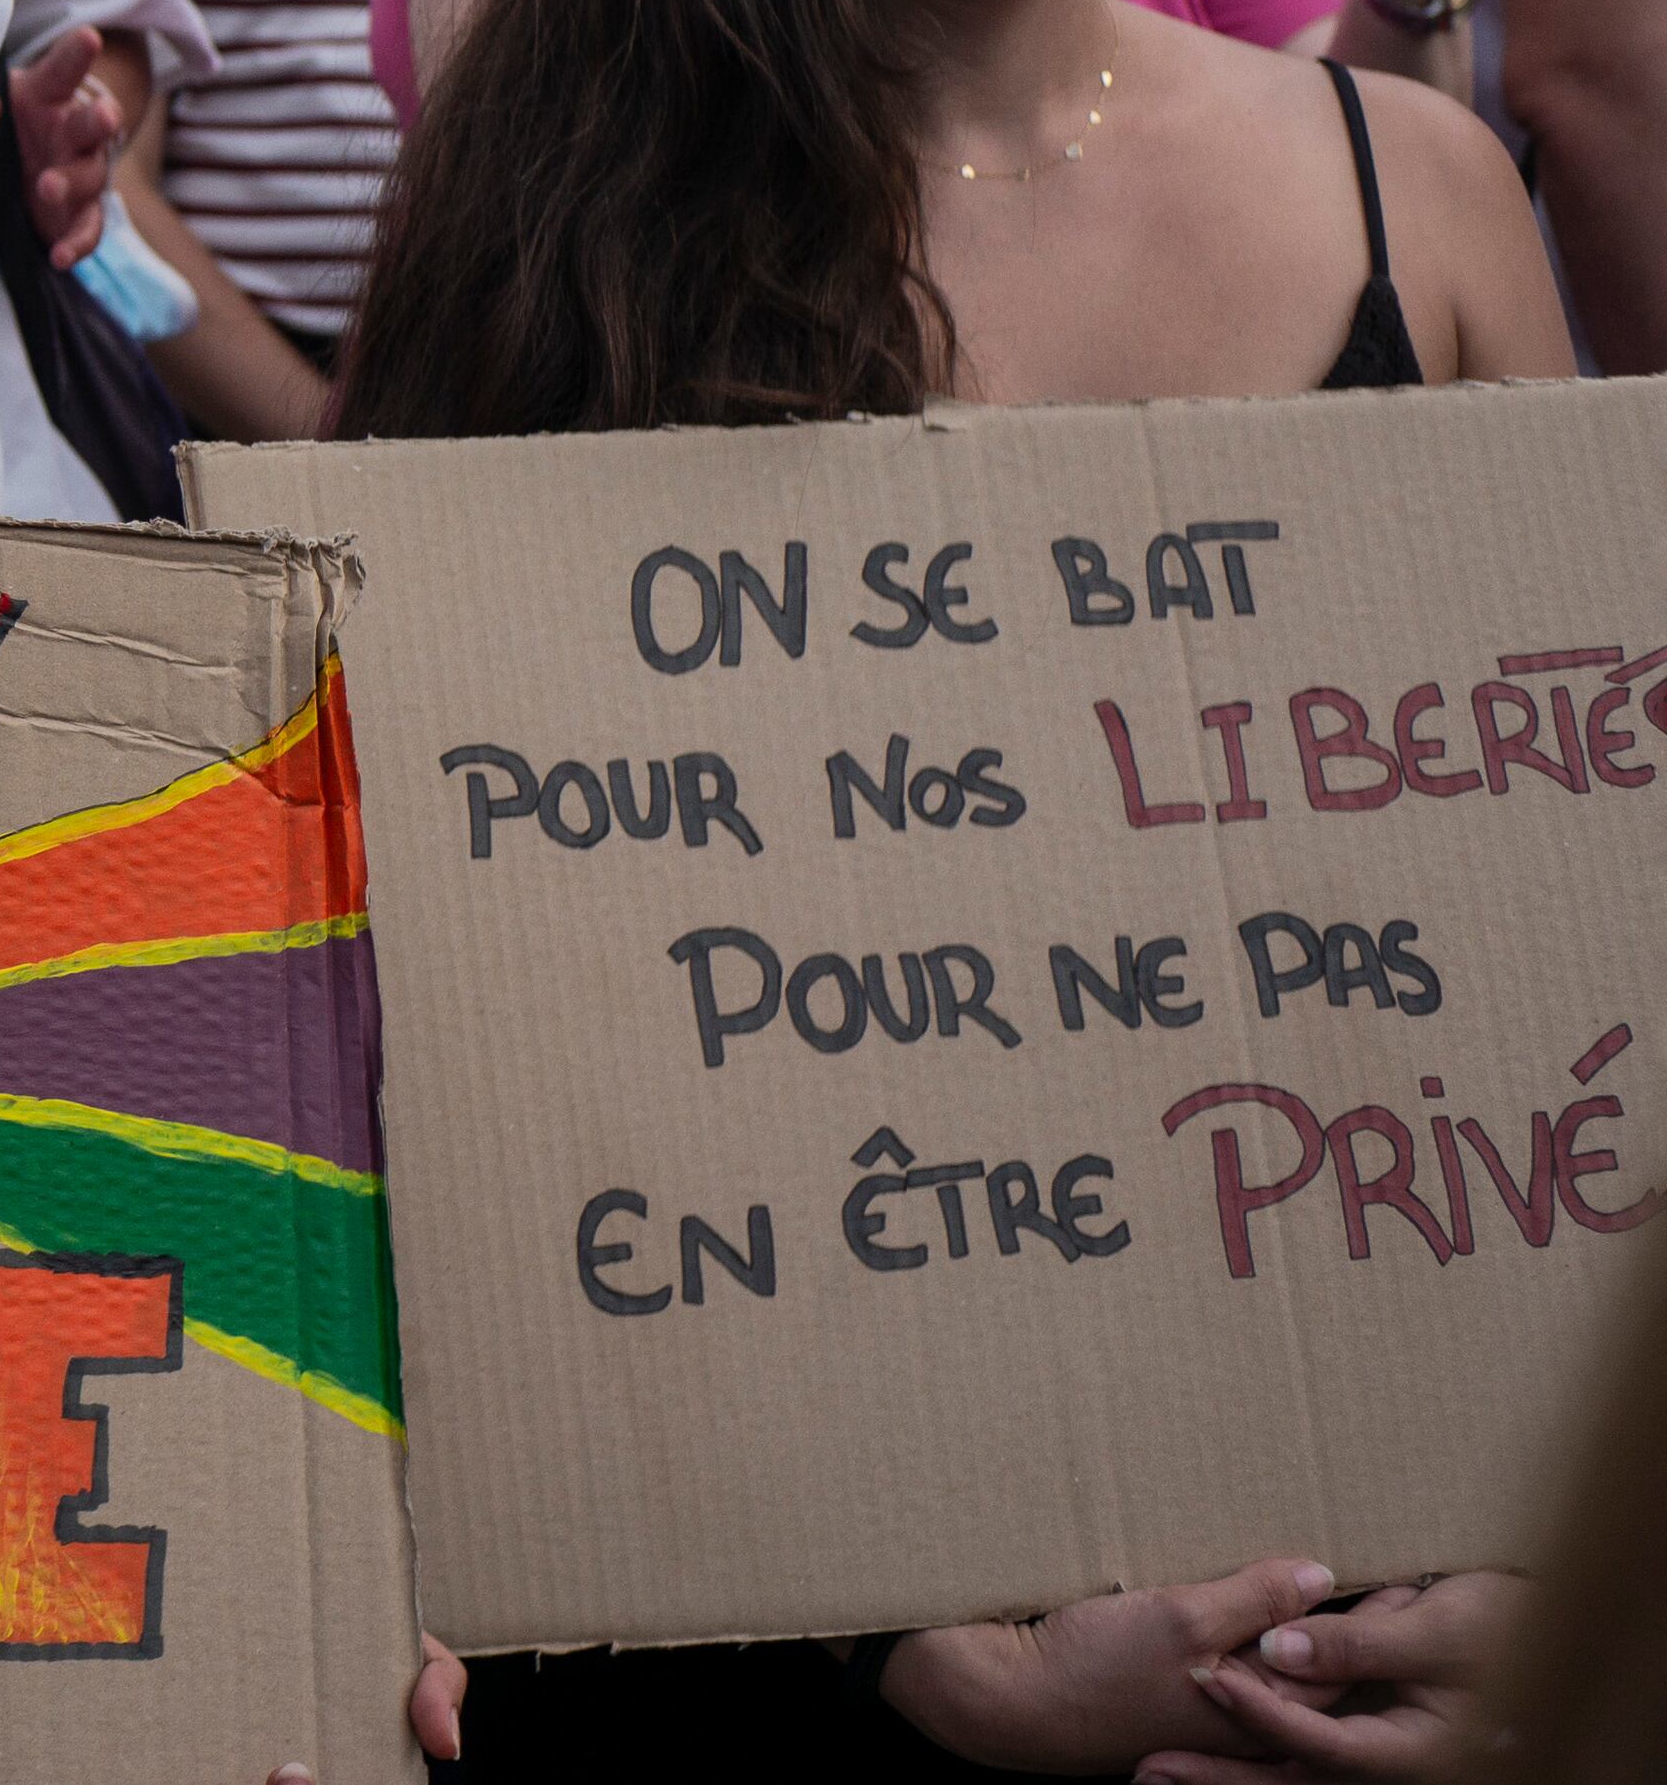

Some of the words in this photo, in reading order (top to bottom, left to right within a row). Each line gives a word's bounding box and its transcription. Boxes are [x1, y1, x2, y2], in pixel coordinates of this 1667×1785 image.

[630, 542, 809, 677] ON
[850, 540, 999, 651] SE
[1052, 520, 1281, 627] BAT
[440, 741, 765, 859] POUR
[1093, 645, 1667, 829] LIBERTÉ
[667, 924, 1023, 1069] POUR
[1047, 933, 1206, 1032] NE
[1238, 911, 1443, 1017] PAS
[574, 1187, 776, 1317] EN
[842, 1125, 1133, 1273] ÊTRE
